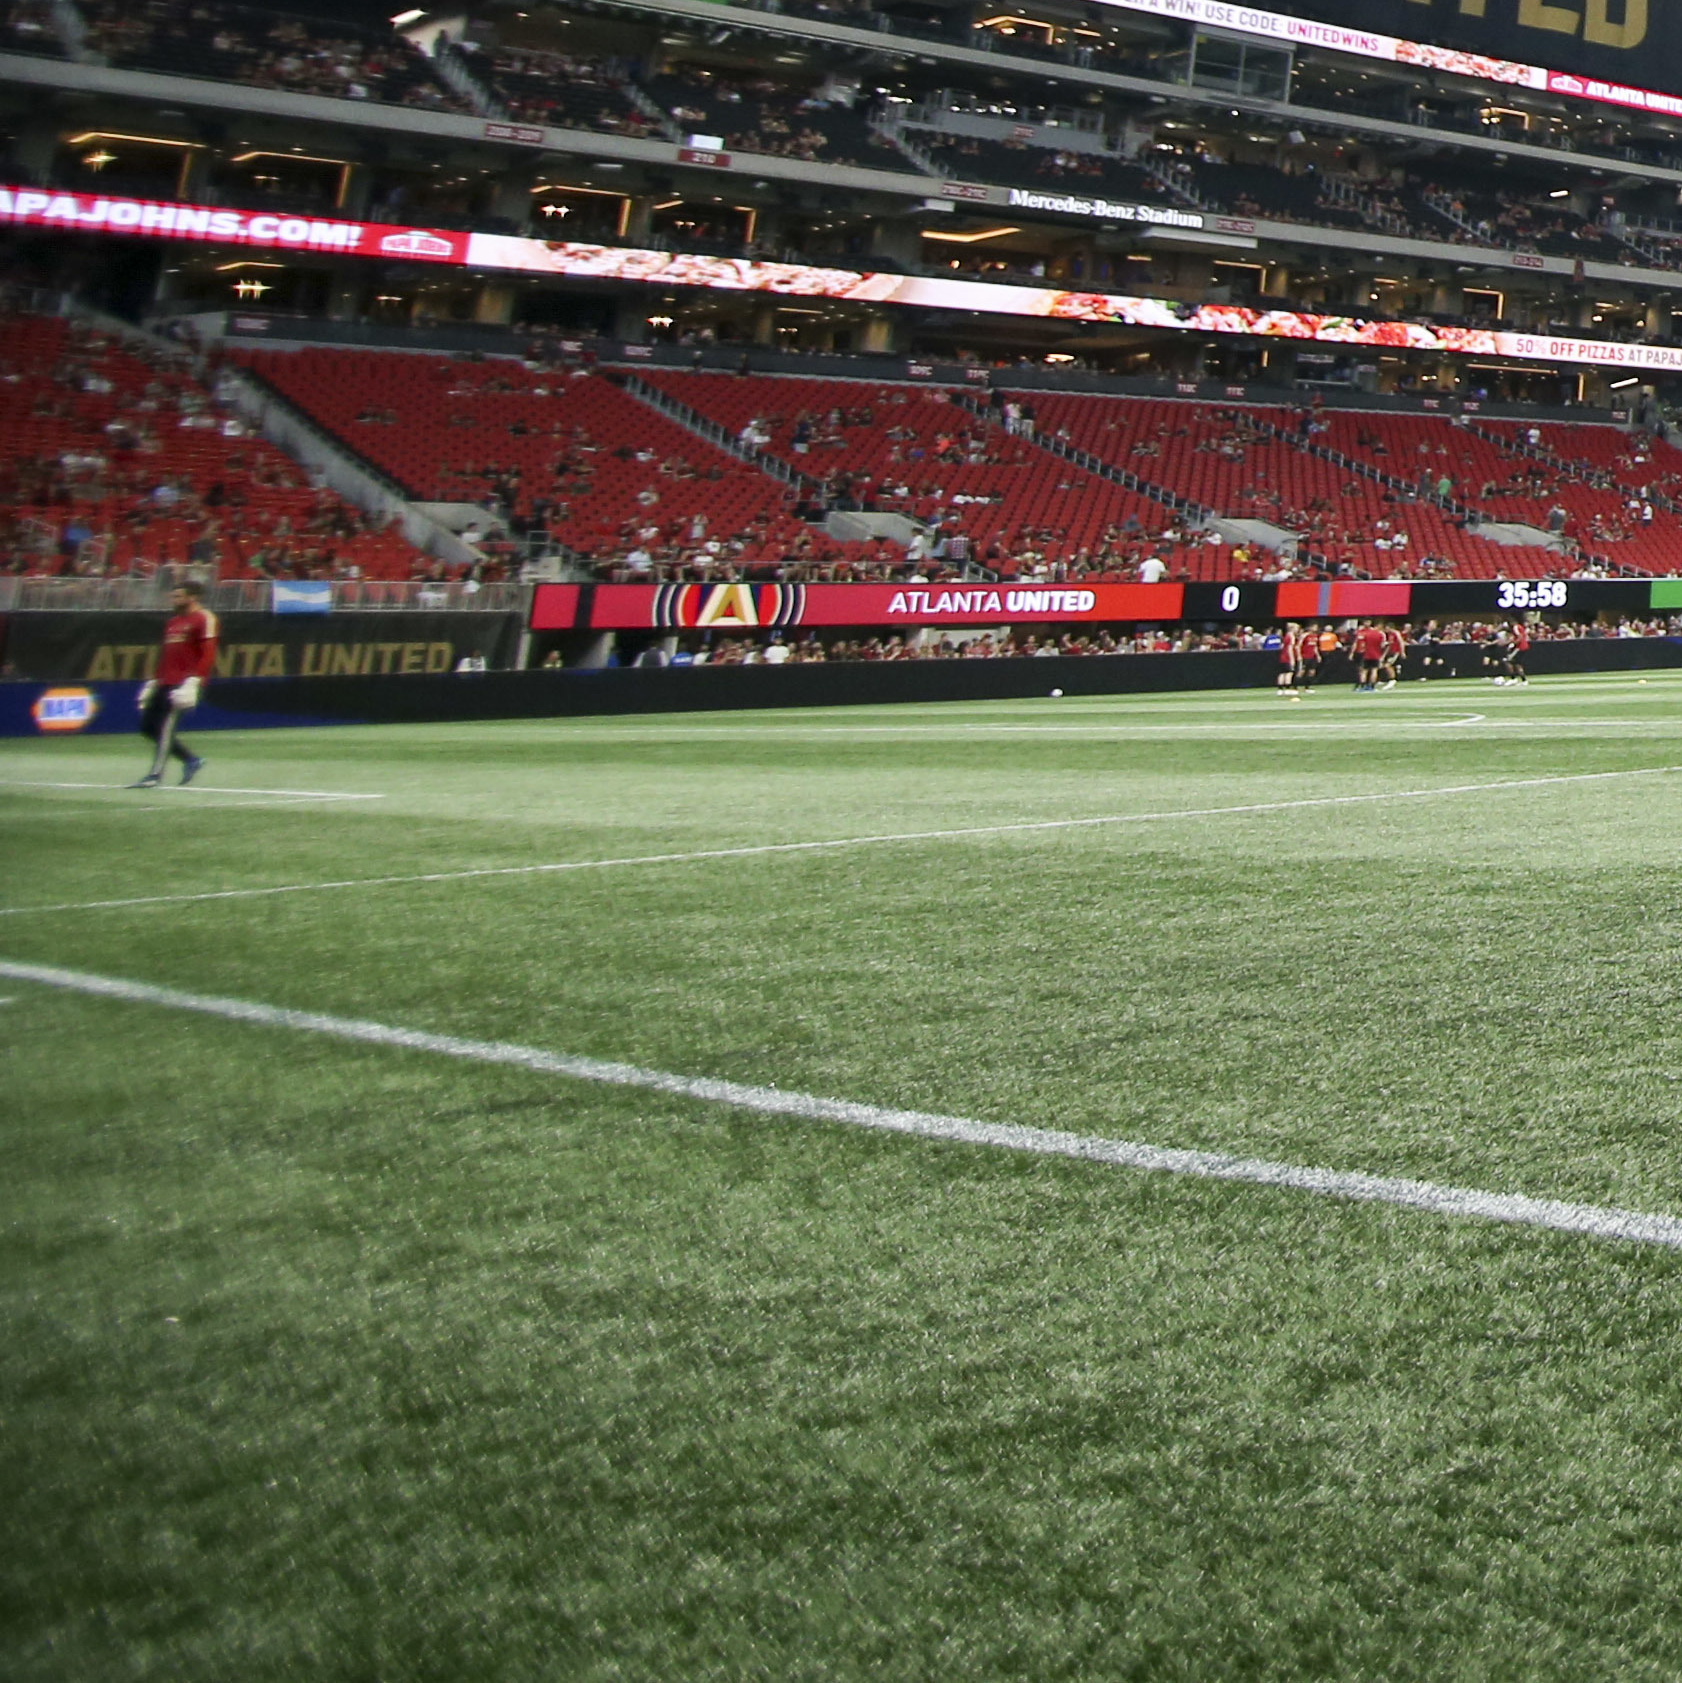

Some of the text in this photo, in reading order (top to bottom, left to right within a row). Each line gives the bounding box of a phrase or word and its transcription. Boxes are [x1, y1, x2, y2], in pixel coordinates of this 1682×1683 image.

[1203, 3, 1234, 24] USE
[1239, 10, 1284, 33] CODE:
[1286, 20, 1380, 53] UNITEDWINS
[1585, 81, 1645, 106] ATLANTA
[1008, 187, 1135, 221] Mercedes-Benz
[1136, 203, 1203, 230] Stadium
[1549, 342, 1576, 358] OFF
[1578, 344, 1625, 362] PIZZAS
[1627, 349, 1644, 363] AT
[887, 589, 1096, 614] ATLANTA UNITED
[1220, 585, 1241, 612] 0
[1497, 581, 1569, 609] 35:58
[301, 641, 453, 677] UNITED
